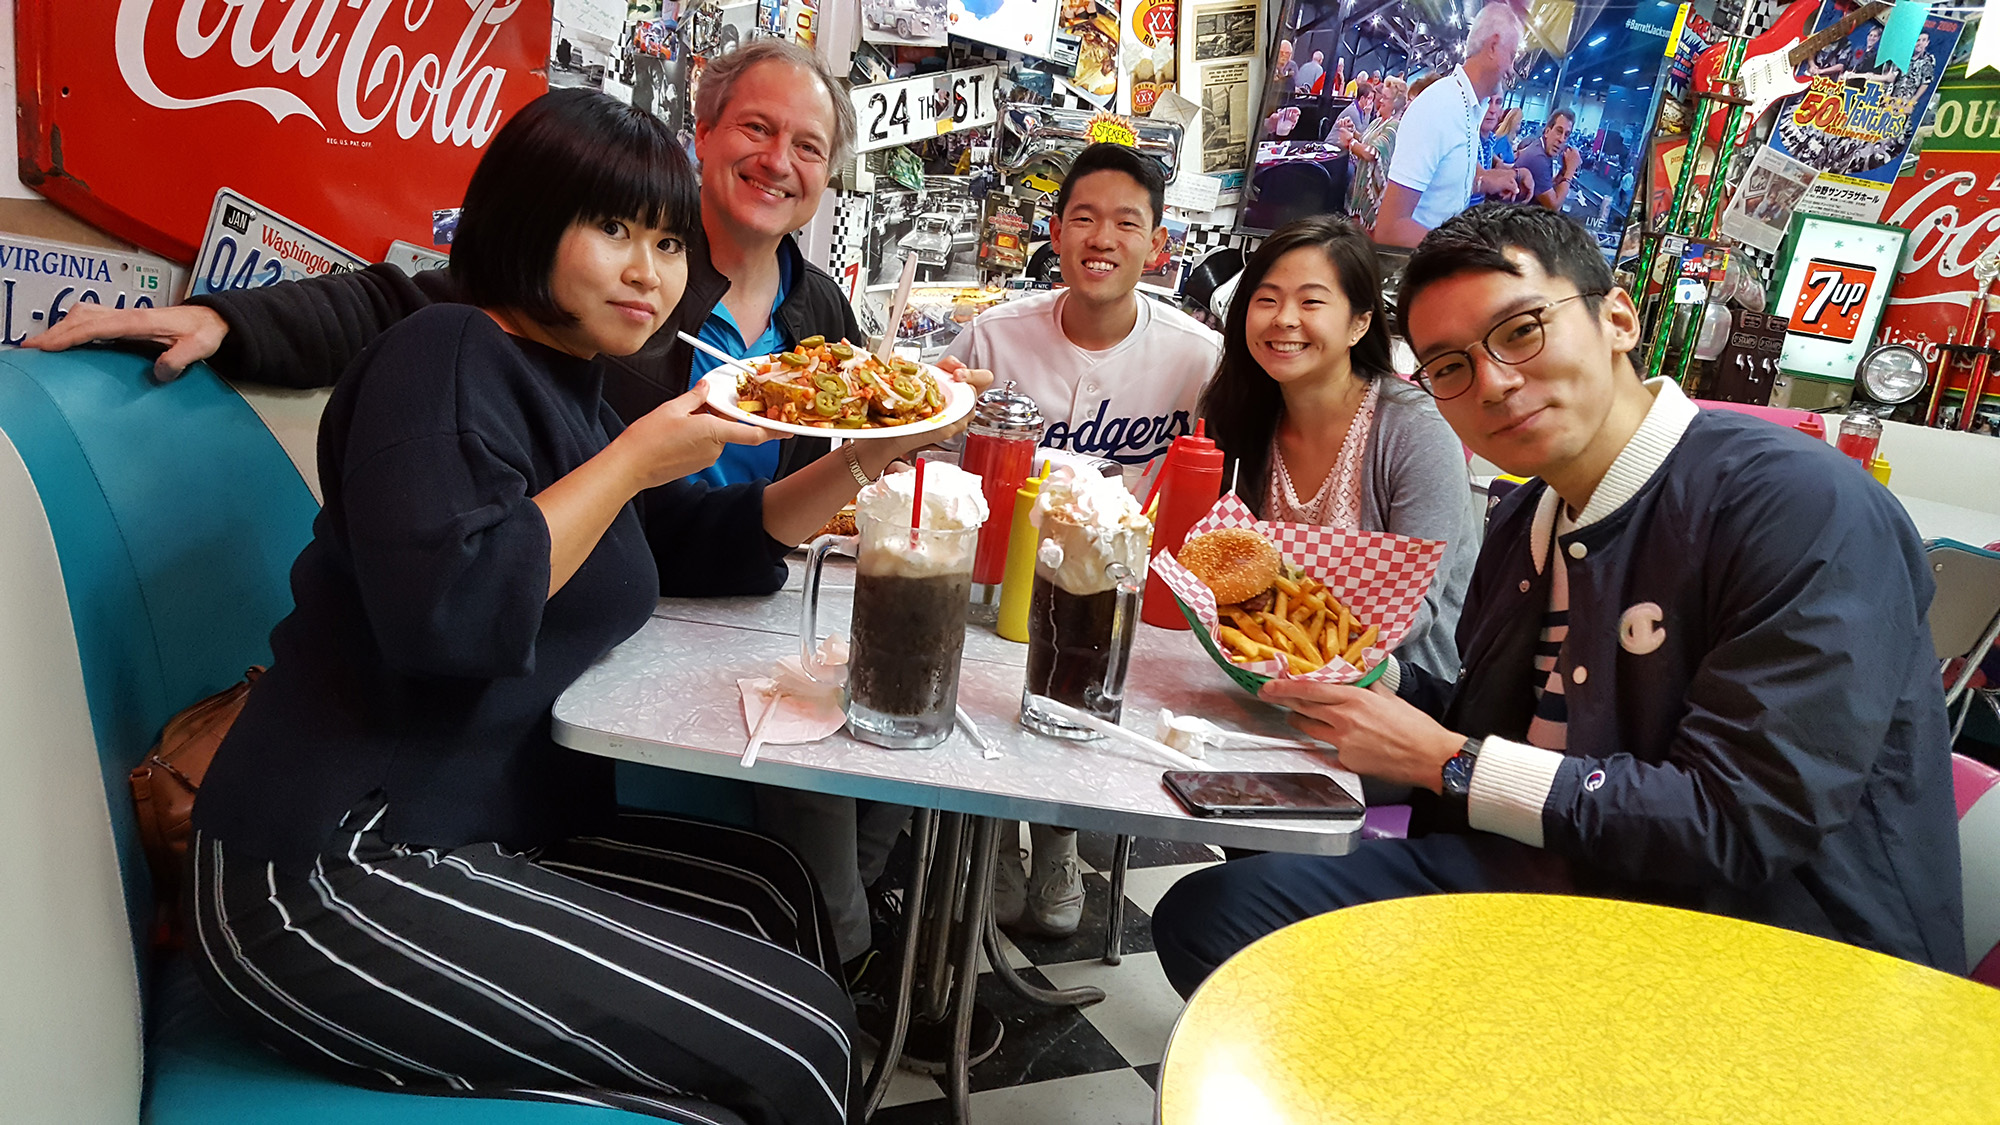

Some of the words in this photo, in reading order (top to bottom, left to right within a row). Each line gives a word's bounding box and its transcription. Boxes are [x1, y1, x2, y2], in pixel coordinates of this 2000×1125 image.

[1135, 91, 1155, 103] XXX
[868, 88, 910, 142] 24
[918, 95, 936, 120] TH
[1844, 88, 1905, 139] VENTURES
[1823, 124, 1881, 144] Anniversary
[1814, 184, 1880, 204] 中野サンプラザホール
[228, 209, 248, 230] JAN
[1585, 216, 1606, 228] LIVE
[262, 224, 331, 275] Washingto
[0, 244, 113, 283] VIRGINIA
[1682, 261, 1709, 273] CUBA
[140, 275, 158, 290] 15
[1039, 398, 1193, 464] odgers
[1619, 602, 1666, 655] C
